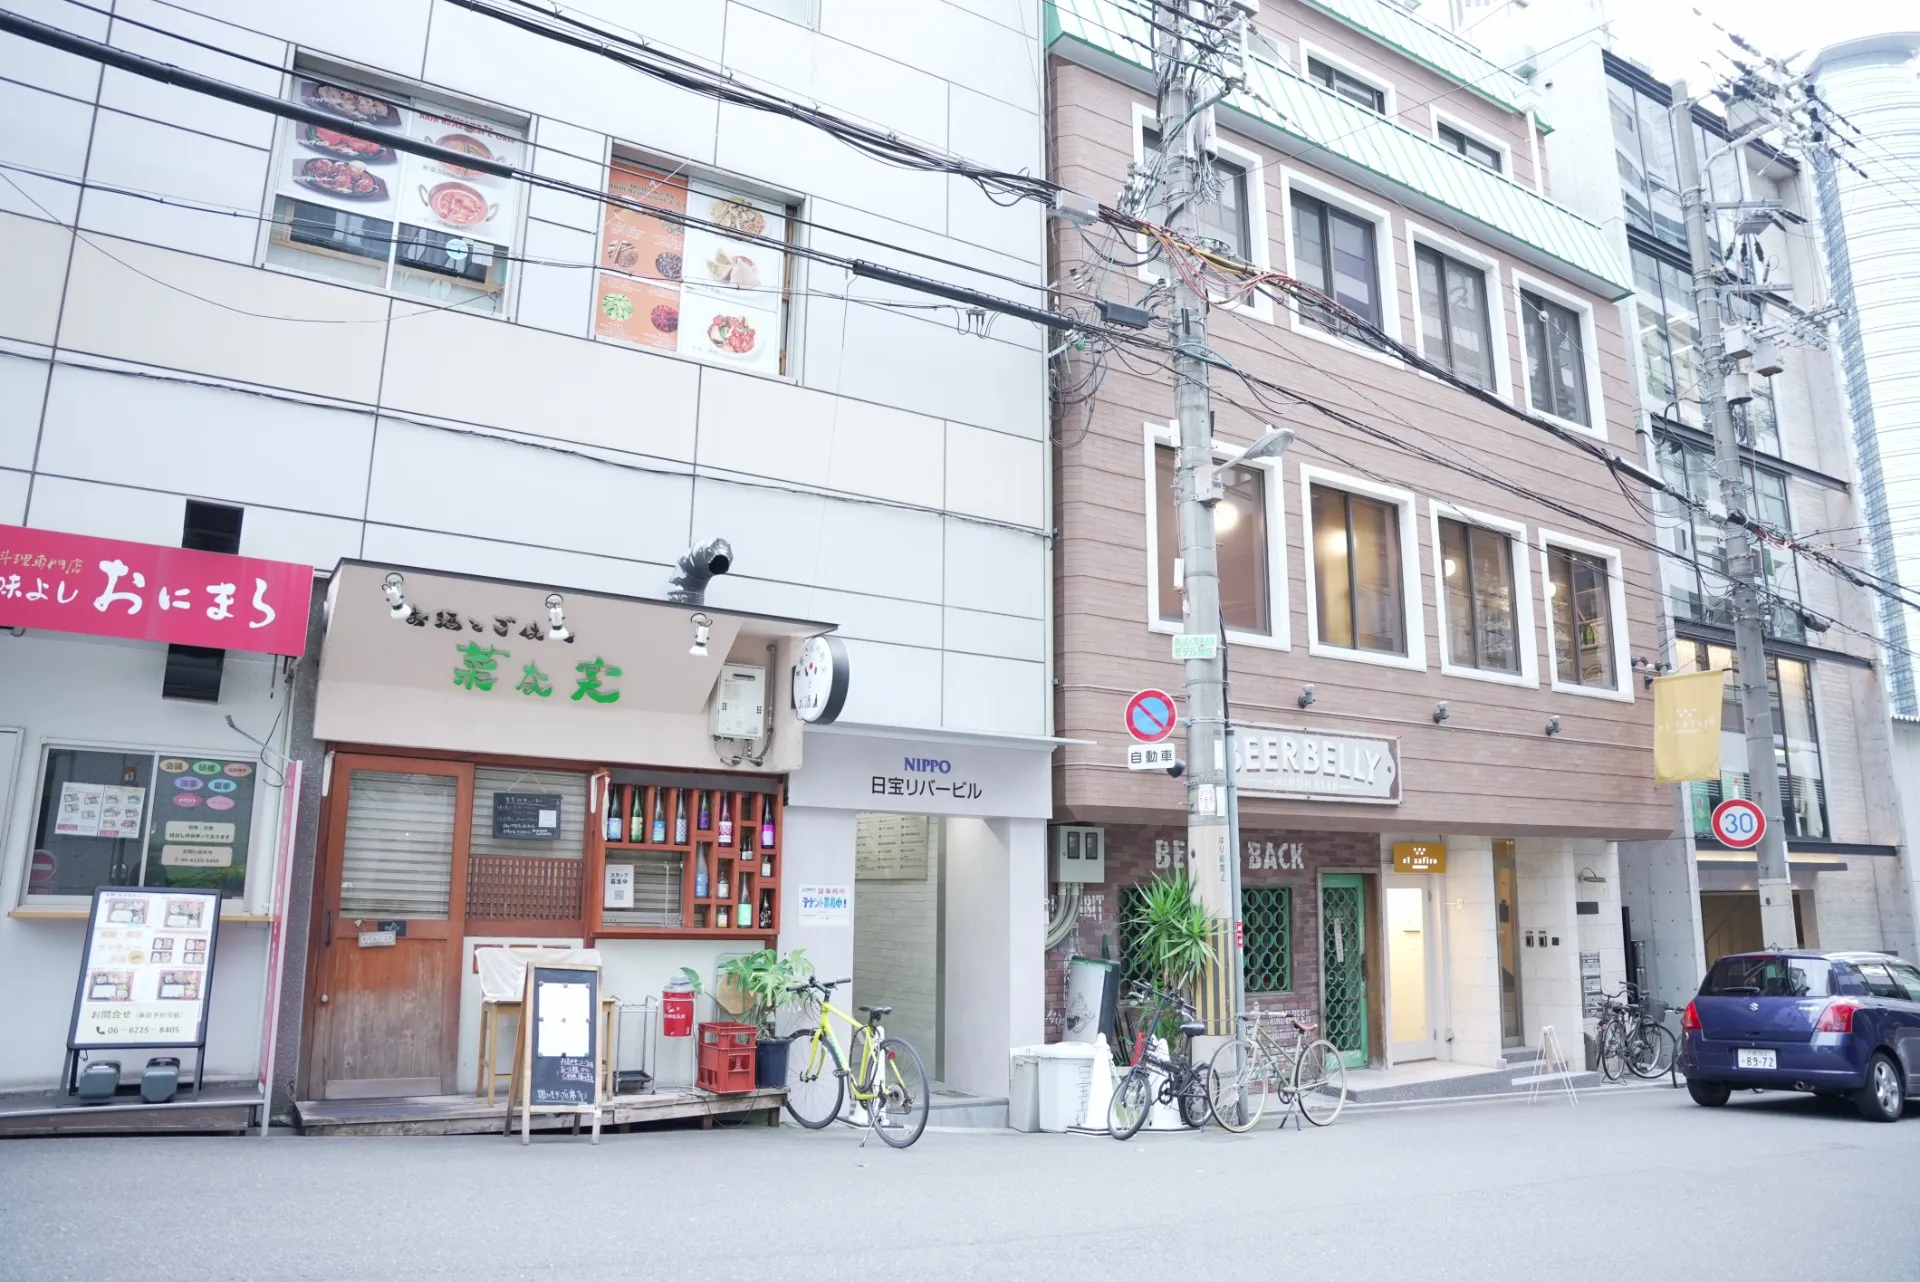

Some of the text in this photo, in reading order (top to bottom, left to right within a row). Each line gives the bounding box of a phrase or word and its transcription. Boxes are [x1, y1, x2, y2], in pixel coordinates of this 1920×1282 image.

[1130, 749, 1173, 764] 自動車
[904, 757, 951, 774] NIPPO
[872, 776, 982, 799] 日宝リバービル
[1724, 812, 1754, 834] 30
[1248, 841, 1304, 870] BACK
[1402, 856, 1411, 865] el
[1746, 1056, 1775, 1068] 89-72
